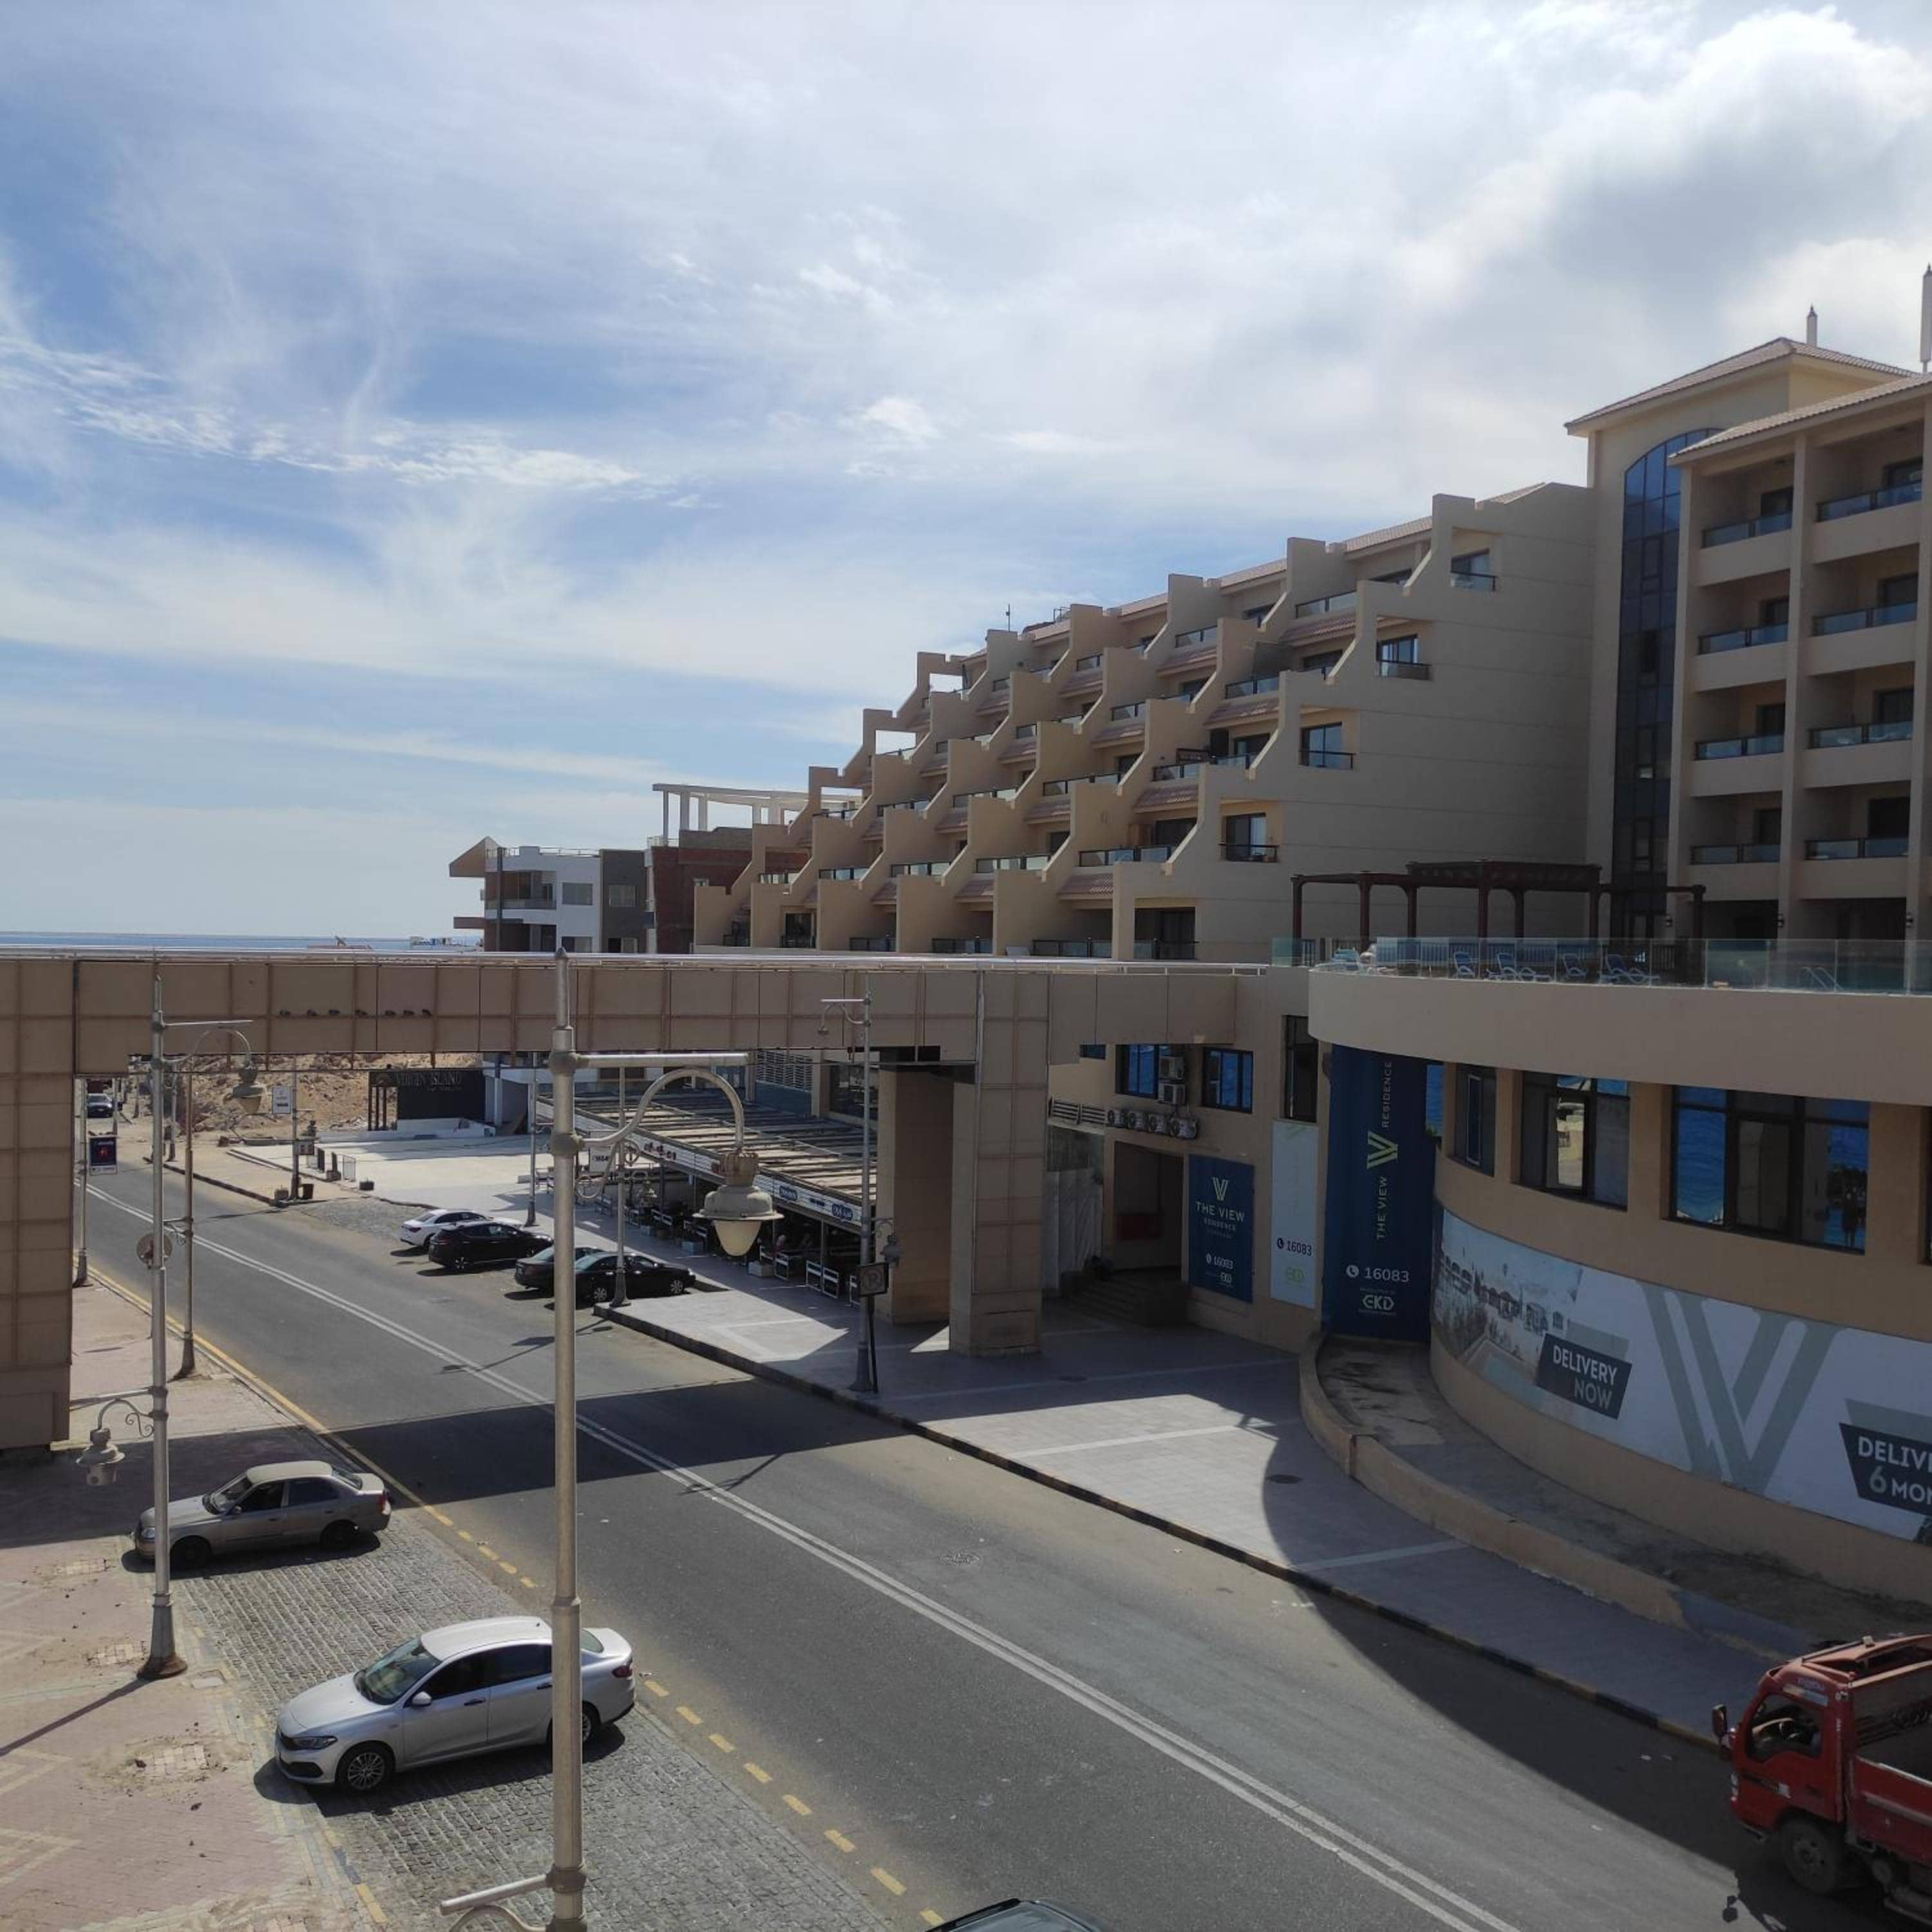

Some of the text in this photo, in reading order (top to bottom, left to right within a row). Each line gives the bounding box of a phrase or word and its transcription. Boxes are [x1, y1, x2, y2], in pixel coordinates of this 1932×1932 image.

[1381, 1061, 1392, 1128] RESIDENCE
[1378, 1176, 1387, 1209] VIEW
[1195, 1200, 1245, 1223] THE VIEW
[1377, 1215, 1386, 1240] THE
[1287, 1240, 1312, 1256] 16083
[1364, 1267, 1410, 1282] 16083
[1553, 1344, 1618, 1386] DELIVERY
[1573, 1378, 1613, 1409] NOW
[1870, 1465, 1887, 1494] 6
